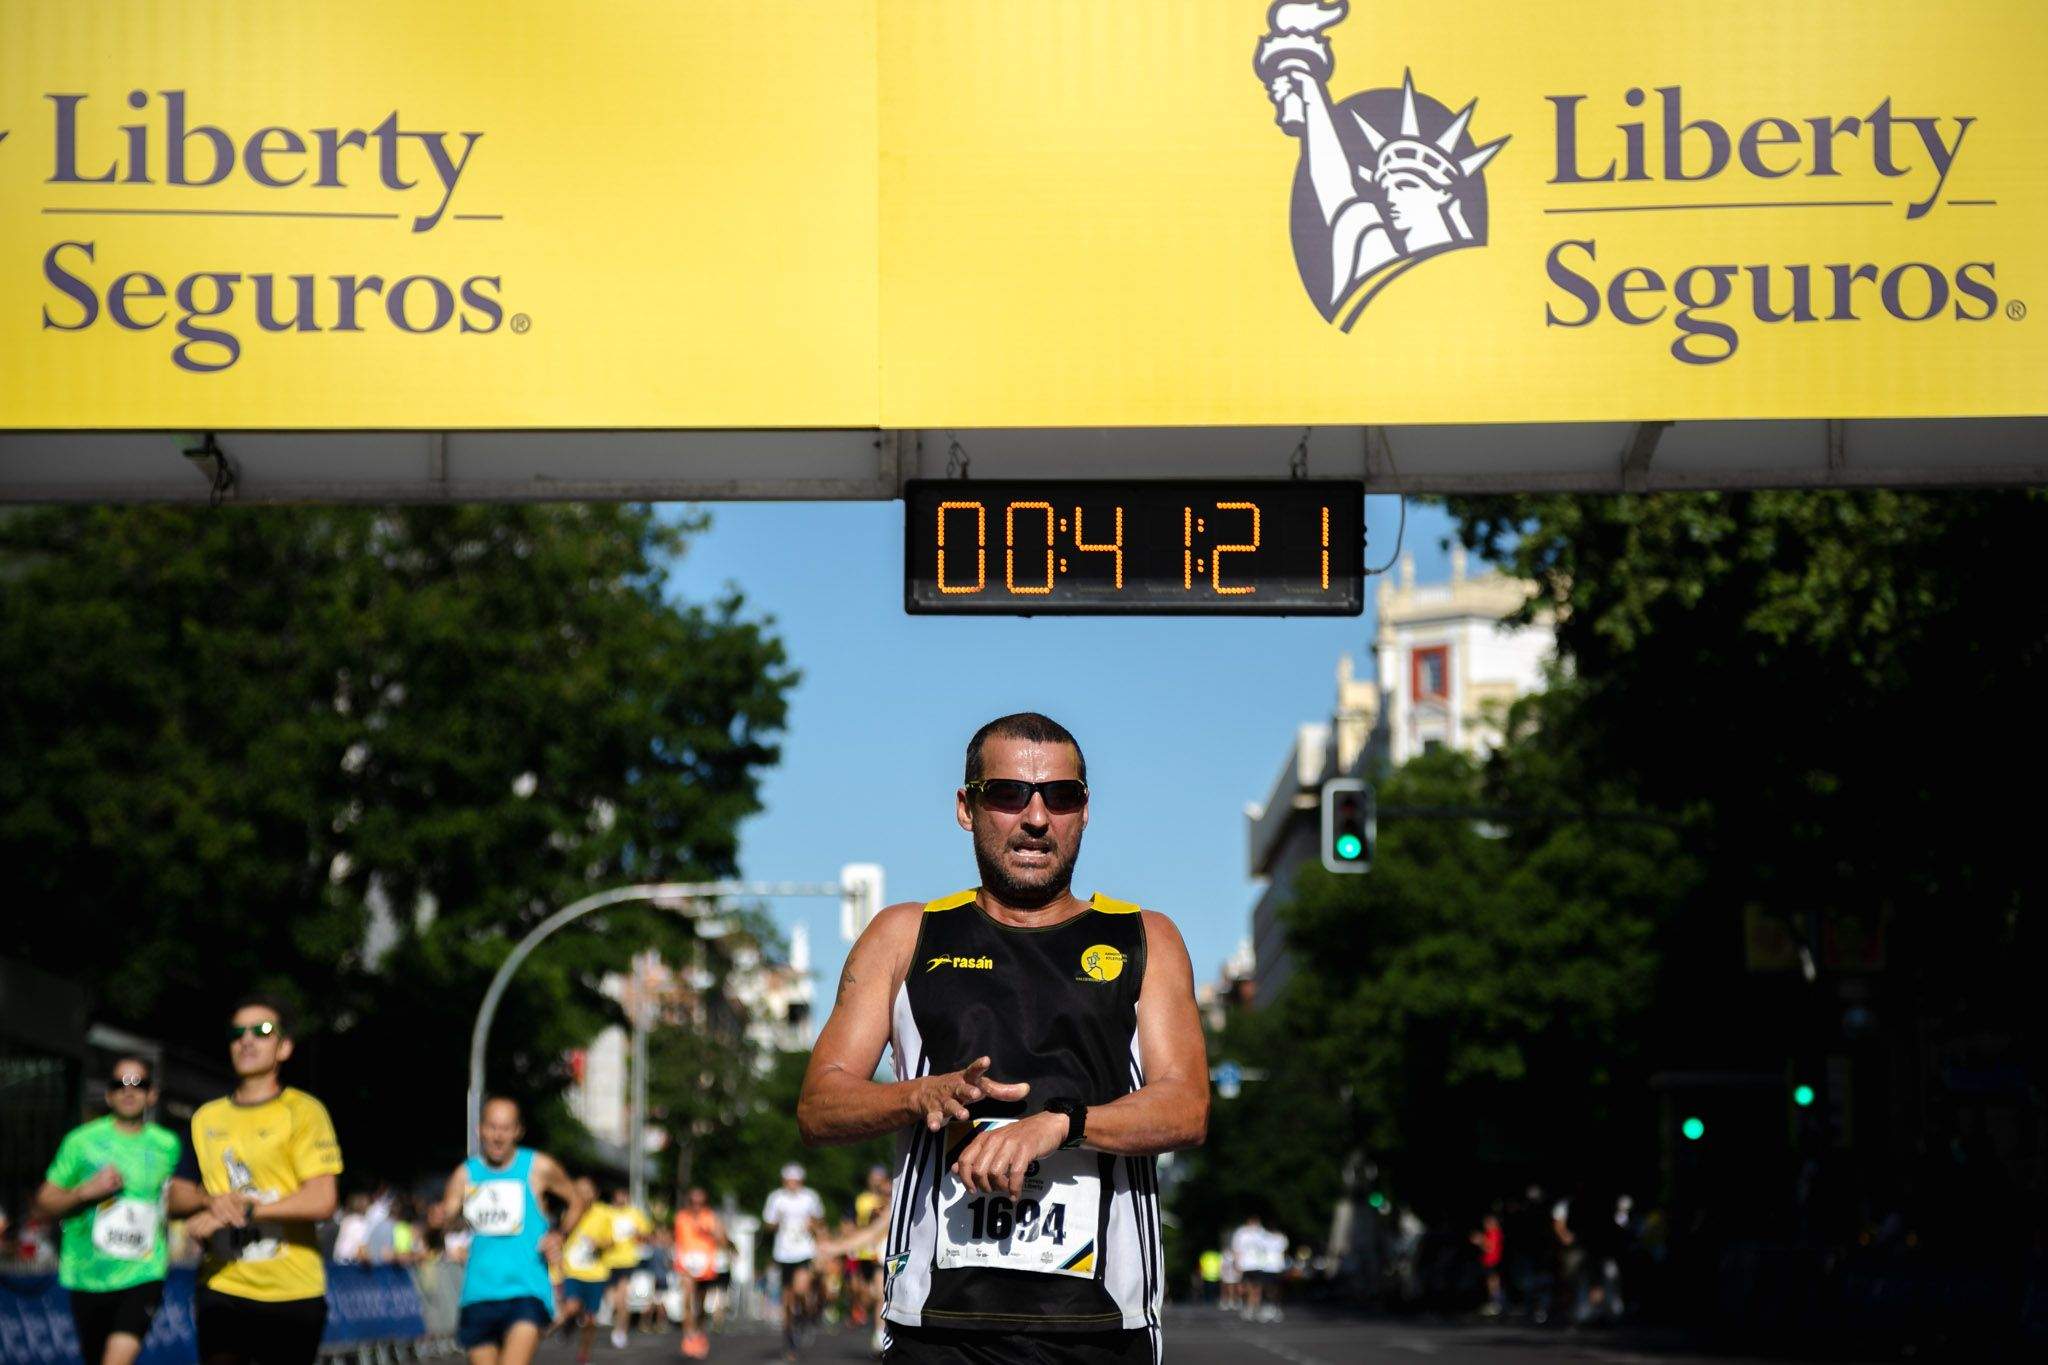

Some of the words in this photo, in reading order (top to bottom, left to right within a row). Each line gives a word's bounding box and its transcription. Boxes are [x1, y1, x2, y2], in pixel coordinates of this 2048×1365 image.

[43, 89, 485, 233] Liberty
[1544, 85, 1979, 220] Liberty
[953, 955, 993, 970] rasán
[968, 1196, 1067, 1246] 1694
